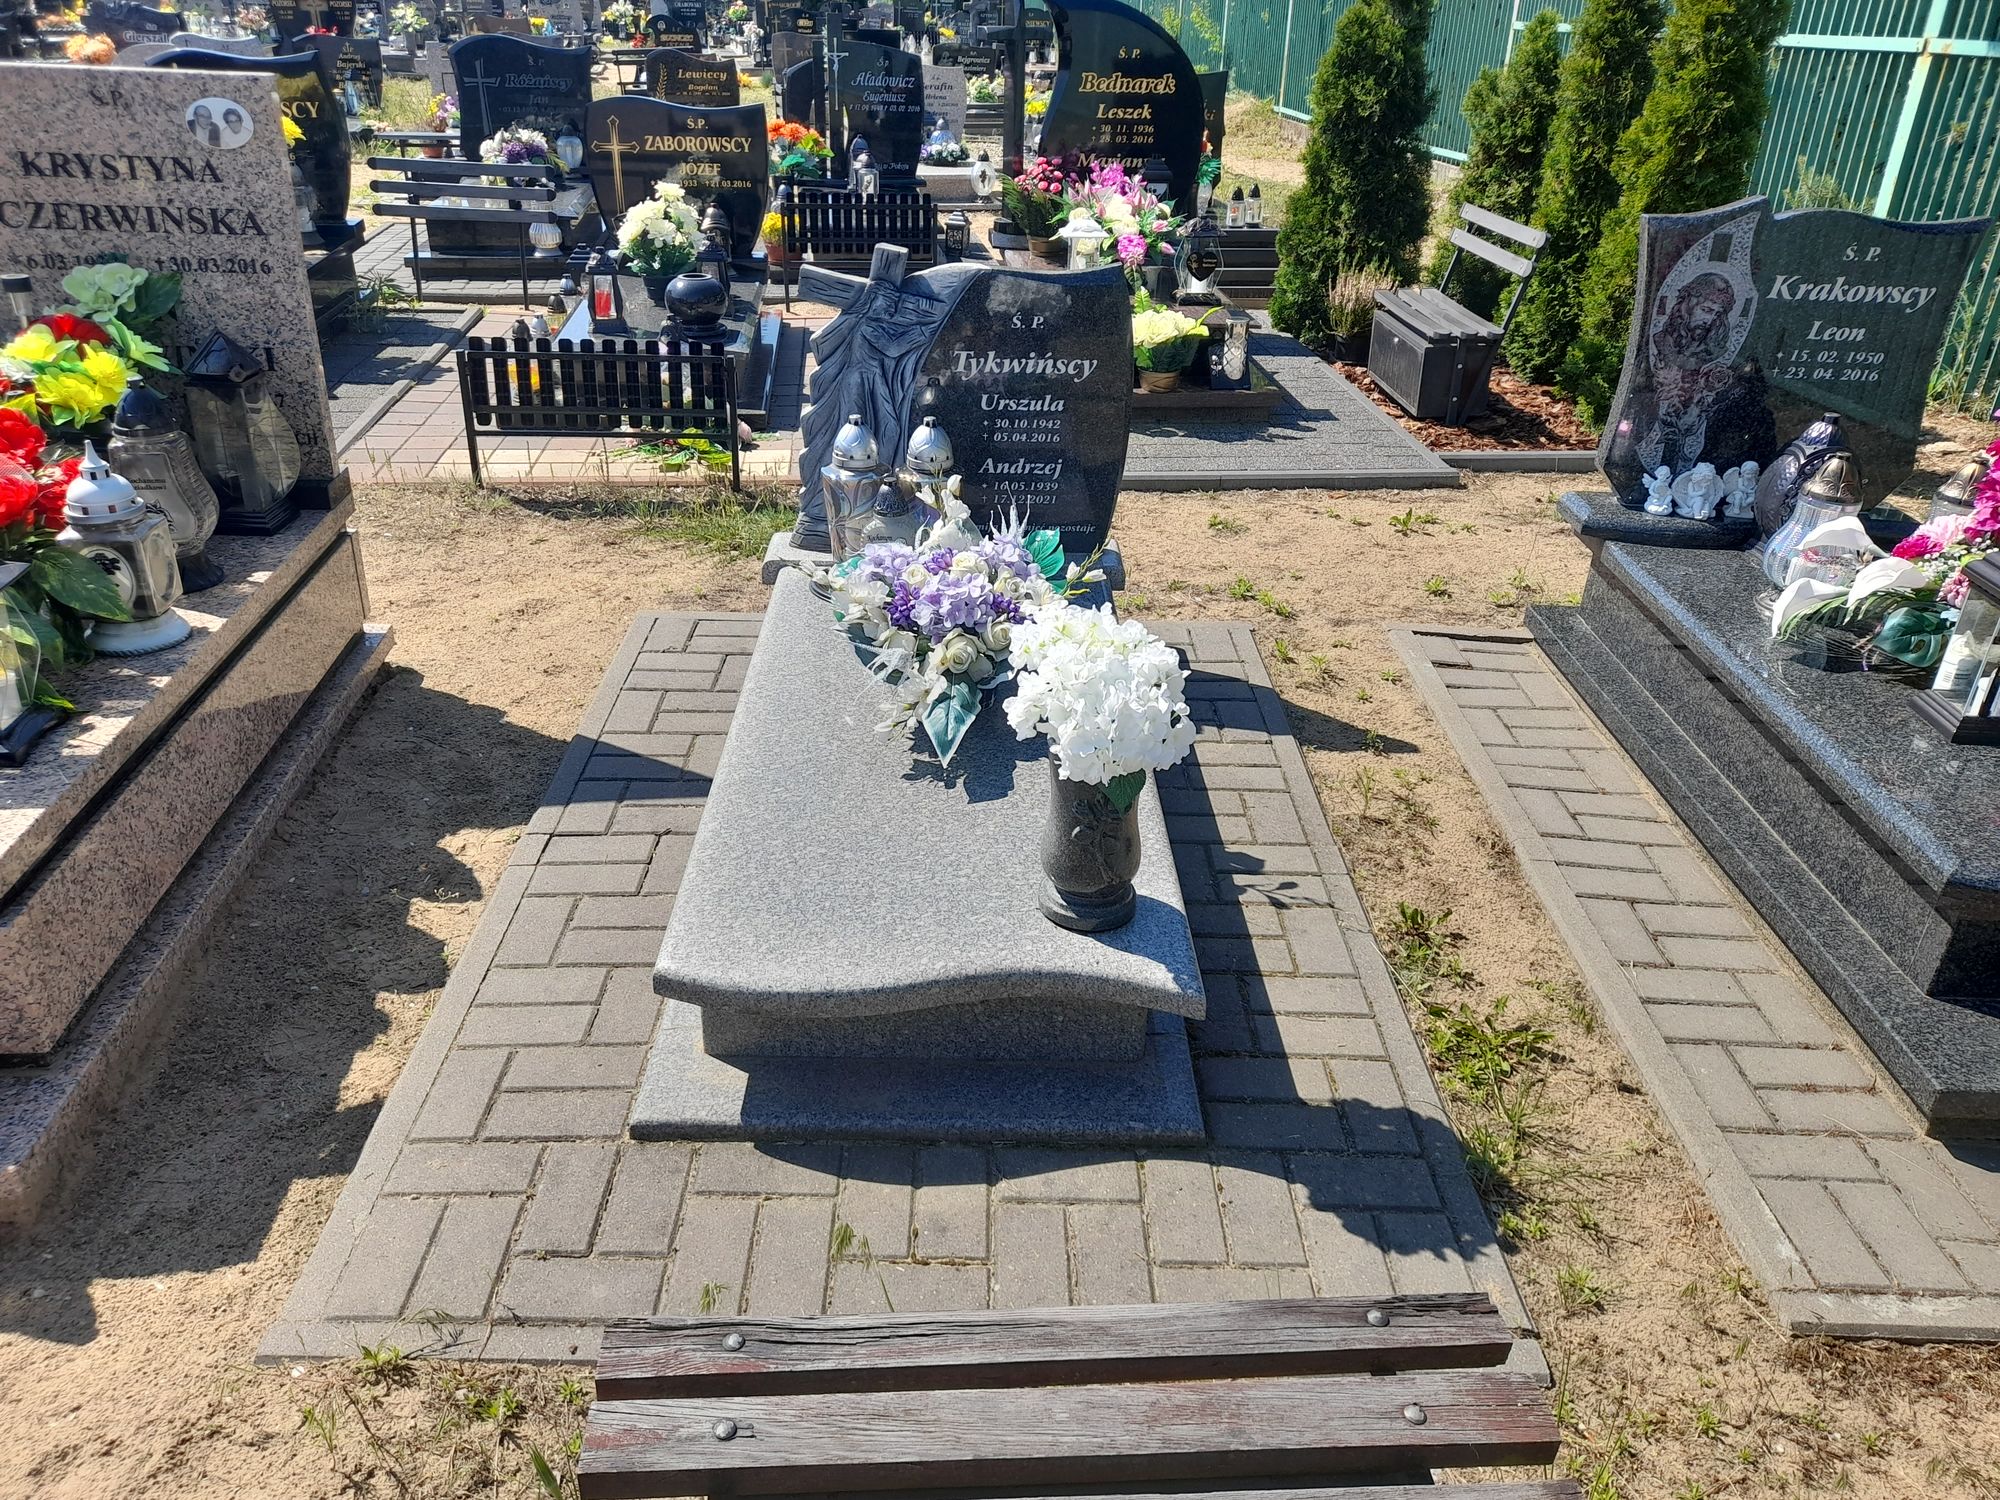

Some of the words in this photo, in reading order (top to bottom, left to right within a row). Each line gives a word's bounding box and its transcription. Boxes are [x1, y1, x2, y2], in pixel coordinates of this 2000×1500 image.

[505, 73, 573, 92] Różańscy
[678, 69, 728, 81] Lewiccy
[851, 71, 916, 88] Aładowicz
[1078, 72, 1176, 95] Bednarek
[687, 83, 718, 92] Bogdan
[863, 90, 907, 103] Eugeniusz
[1096, 103, 1153, 120] Leszek
[1133, 124, 1155, 133] 1936
[644, 135, 752, 153] ZABOROWSCY
[1131, 135, 1154, 144] 2016
[18, 150, 224, 183] KRYSTYNA
[0, 198, 270, 236] CZERWIŃSKA
[1766, 274, 1938, 314] Krakowscy
[1806, 320, 1867, 342] Leon
[953, 350, 1098, 383] Tykwińscy
[1846, 351, 1885, 365] 1950
[1840, 368, 1880, 382] 2016
[980, 393, 1065, 412] Urszula
[993, 418, 1061, 429] 30.10.1942
[993, 432, 1060, 443] 05.04.2016
[977, 457, 1063, 481] Andrzej
[994, 481, 1059, 491] 1605.1939
